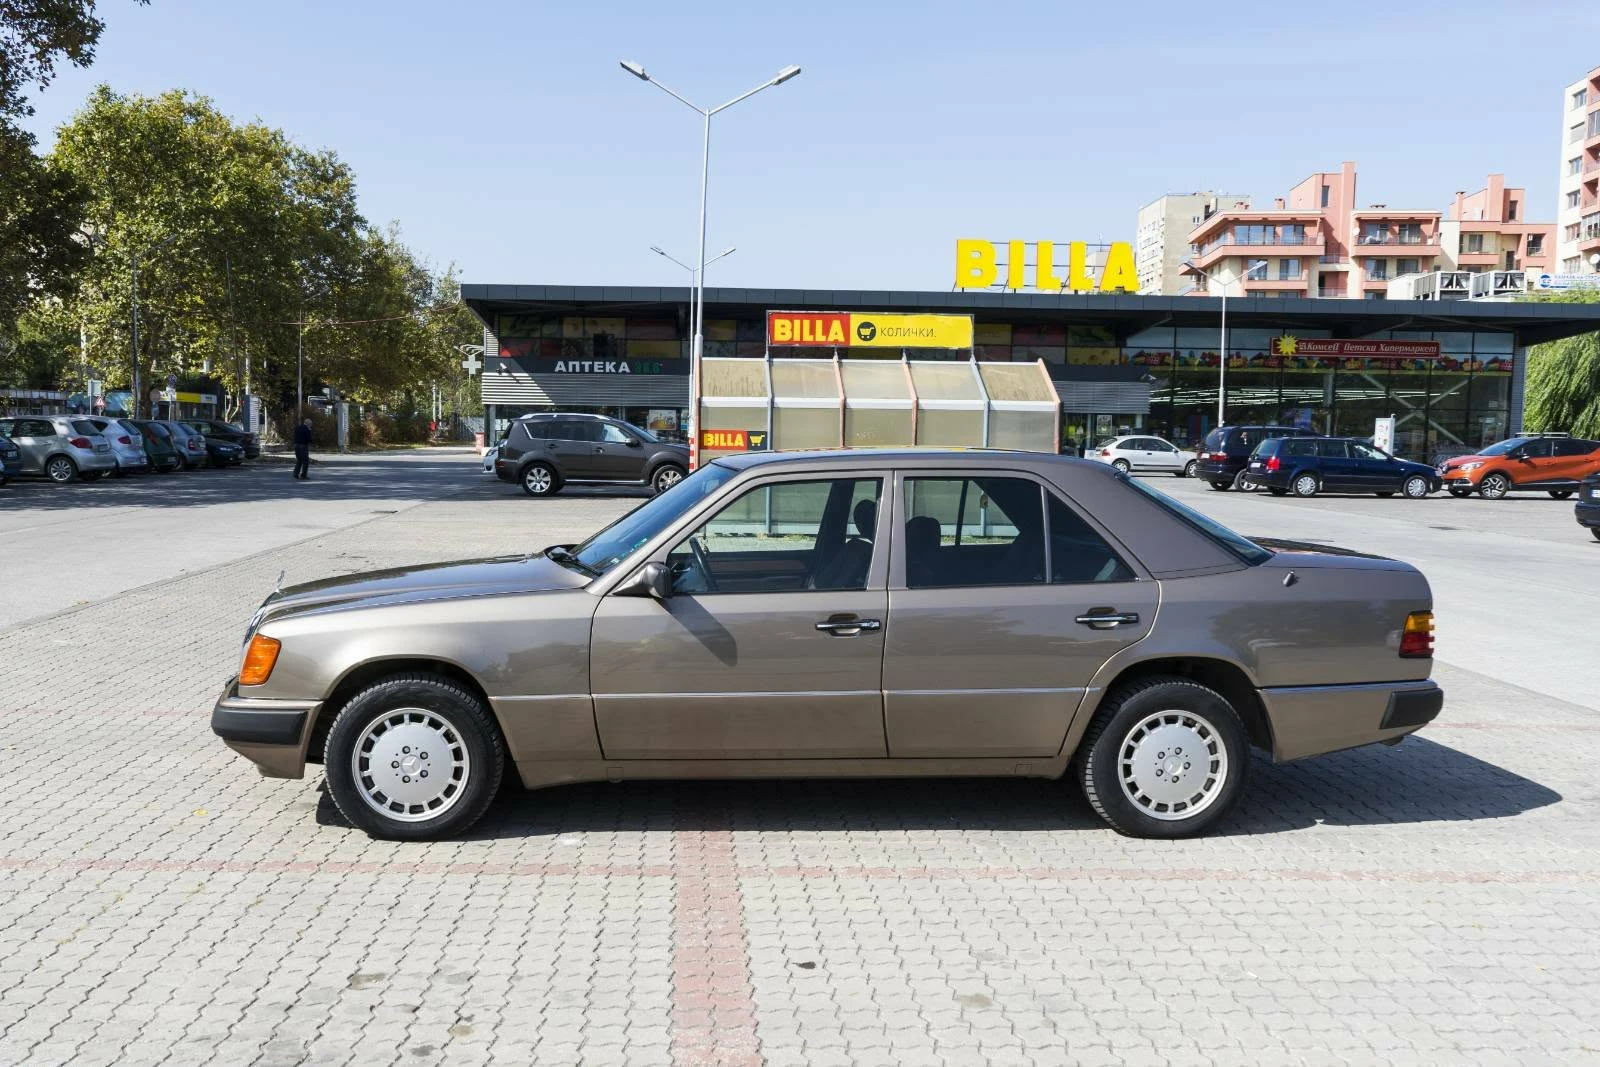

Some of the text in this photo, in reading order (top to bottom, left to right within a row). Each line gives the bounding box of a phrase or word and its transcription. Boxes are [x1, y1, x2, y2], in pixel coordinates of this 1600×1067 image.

[955, 239, 1139, 291] BILLA
[774, 318, 845, 343] BILLA
[554, 361, 631, 373] АПТЕКА
[703, 433, 744, 446] BILLA
